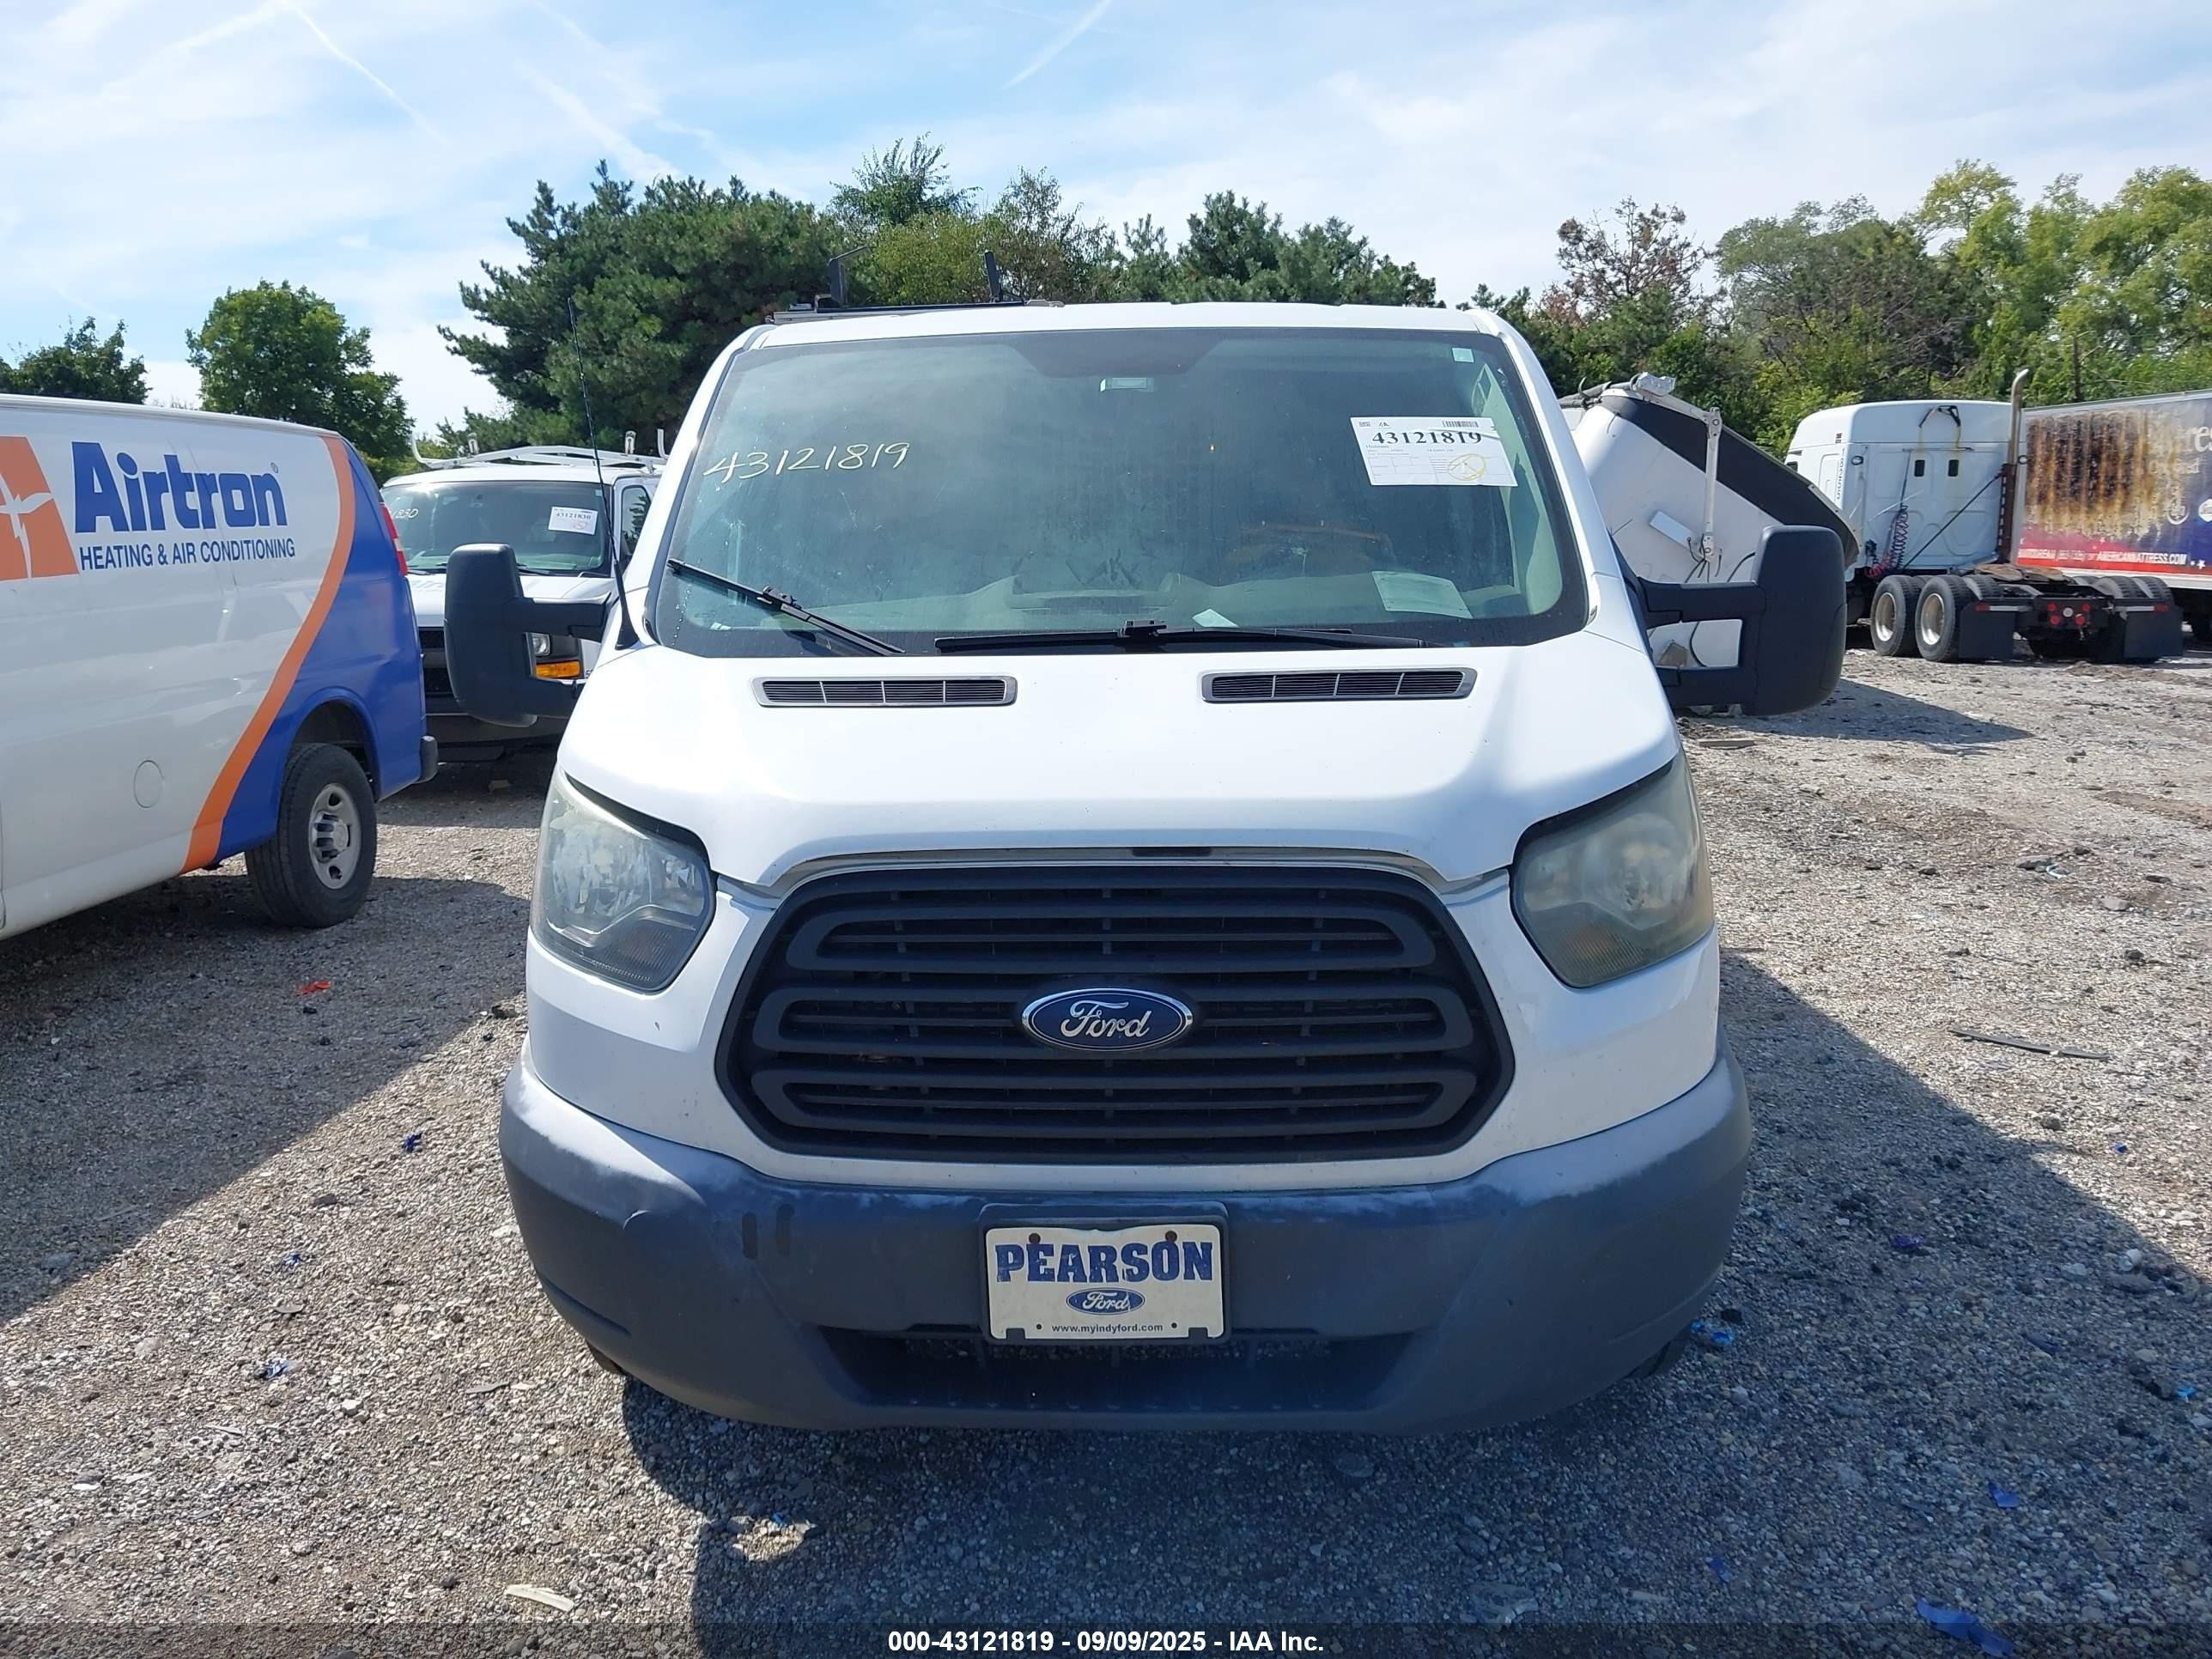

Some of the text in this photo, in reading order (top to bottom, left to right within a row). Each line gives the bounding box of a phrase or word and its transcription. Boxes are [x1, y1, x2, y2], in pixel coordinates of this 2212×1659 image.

[1372, 431, 1482, 445] 43121819
[703, 442, 910, 483] 43121819
[71, 441, 288, 533] Airtron
[80, 538, 295, 571] HEATING & AIR CONDITIONING
[1060, 1000, 1152, 1038] Ford
[994, 1242, 1213, 1283] PEARSON
[1082, 1291, 1131, 1312] Ford
[1052, 1322, 1164, 1334] www.myindyford.com
